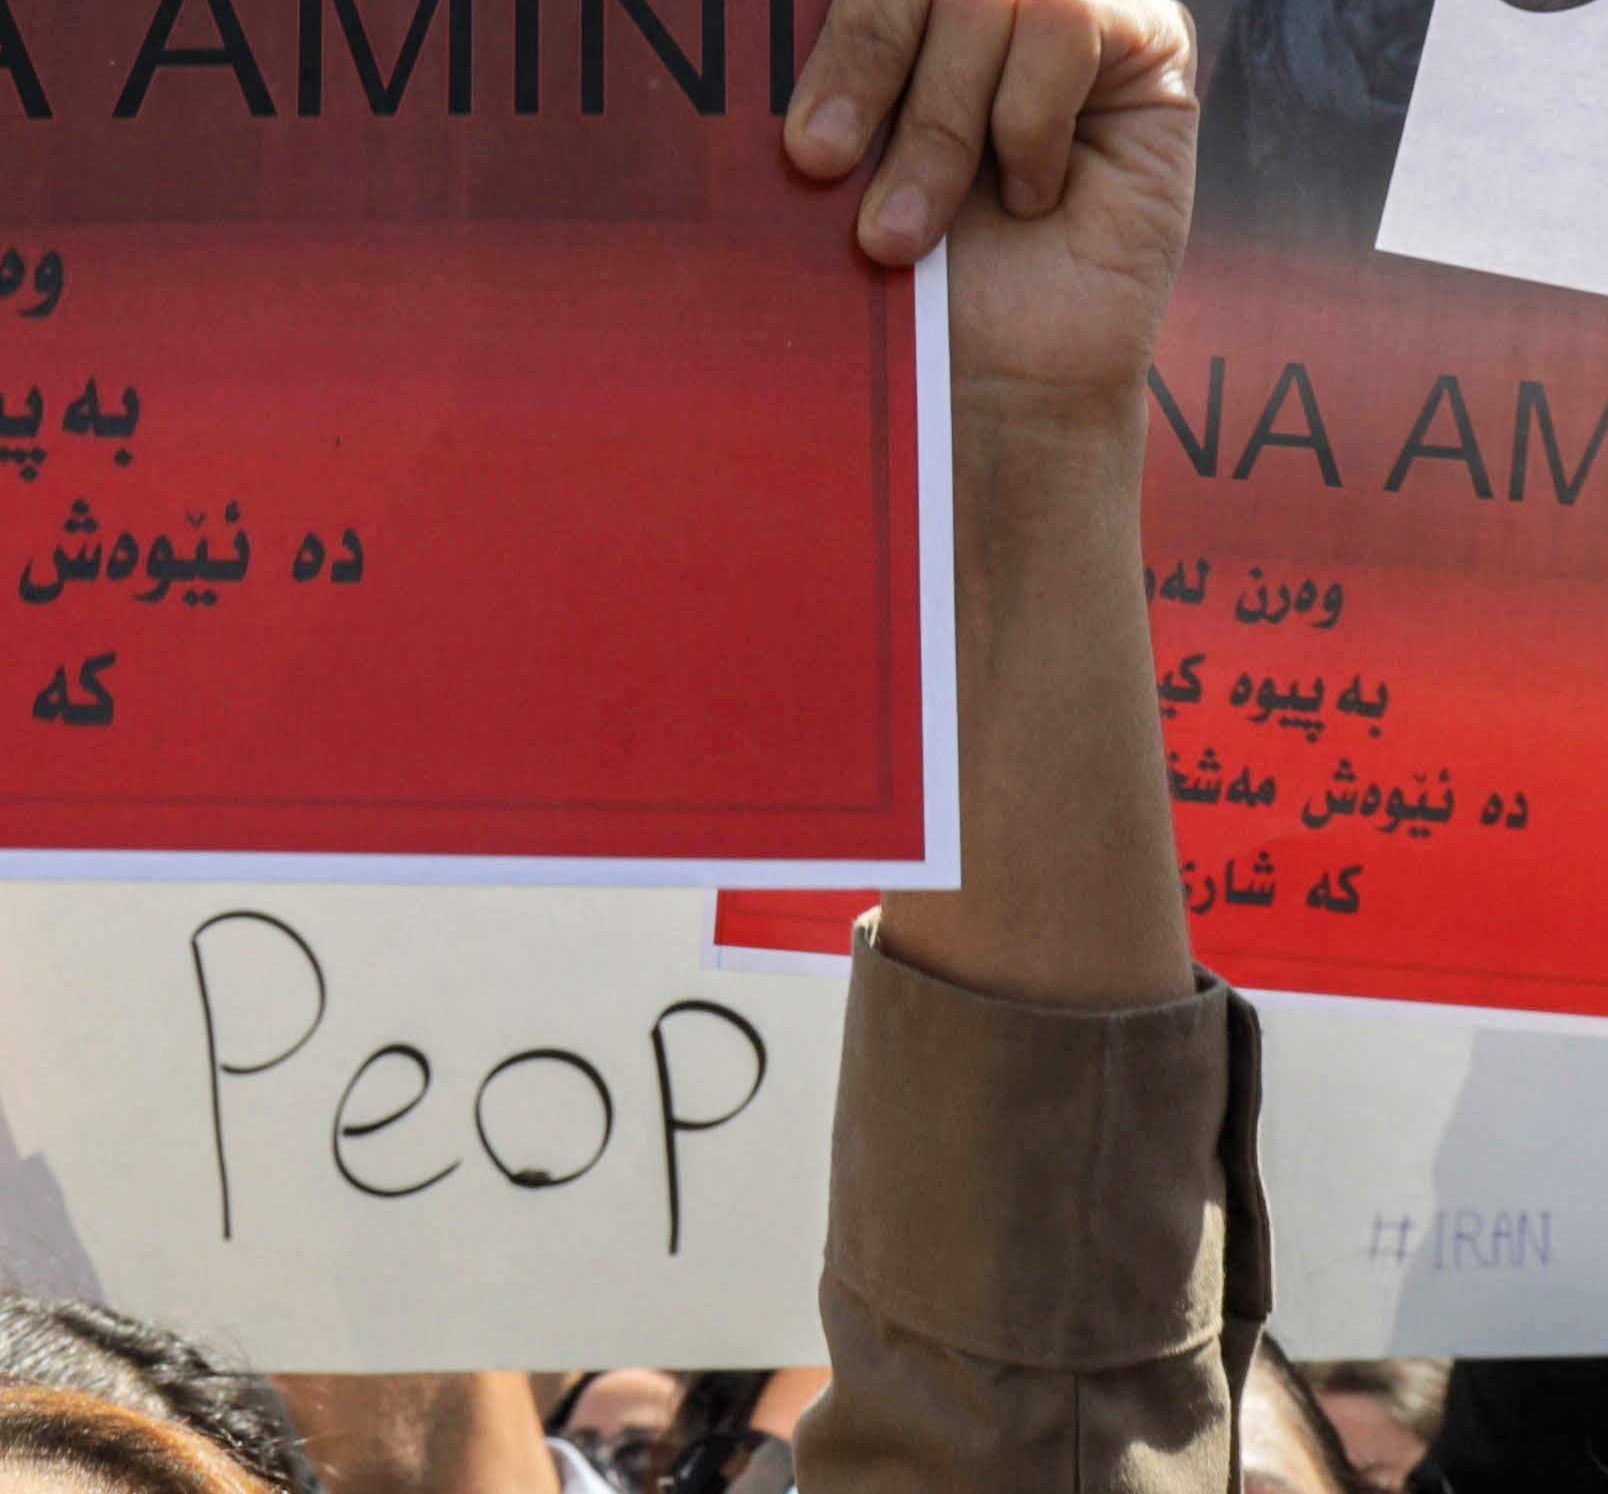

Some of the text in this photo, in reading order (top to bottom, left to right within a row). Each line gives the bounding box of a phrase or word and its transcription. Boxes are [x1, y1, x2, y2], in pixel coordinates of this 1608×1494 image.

[292, 527, 364, 584] دە
[31, 652, 118, 726] کە
[1306, 867, 1364, 914] کە
